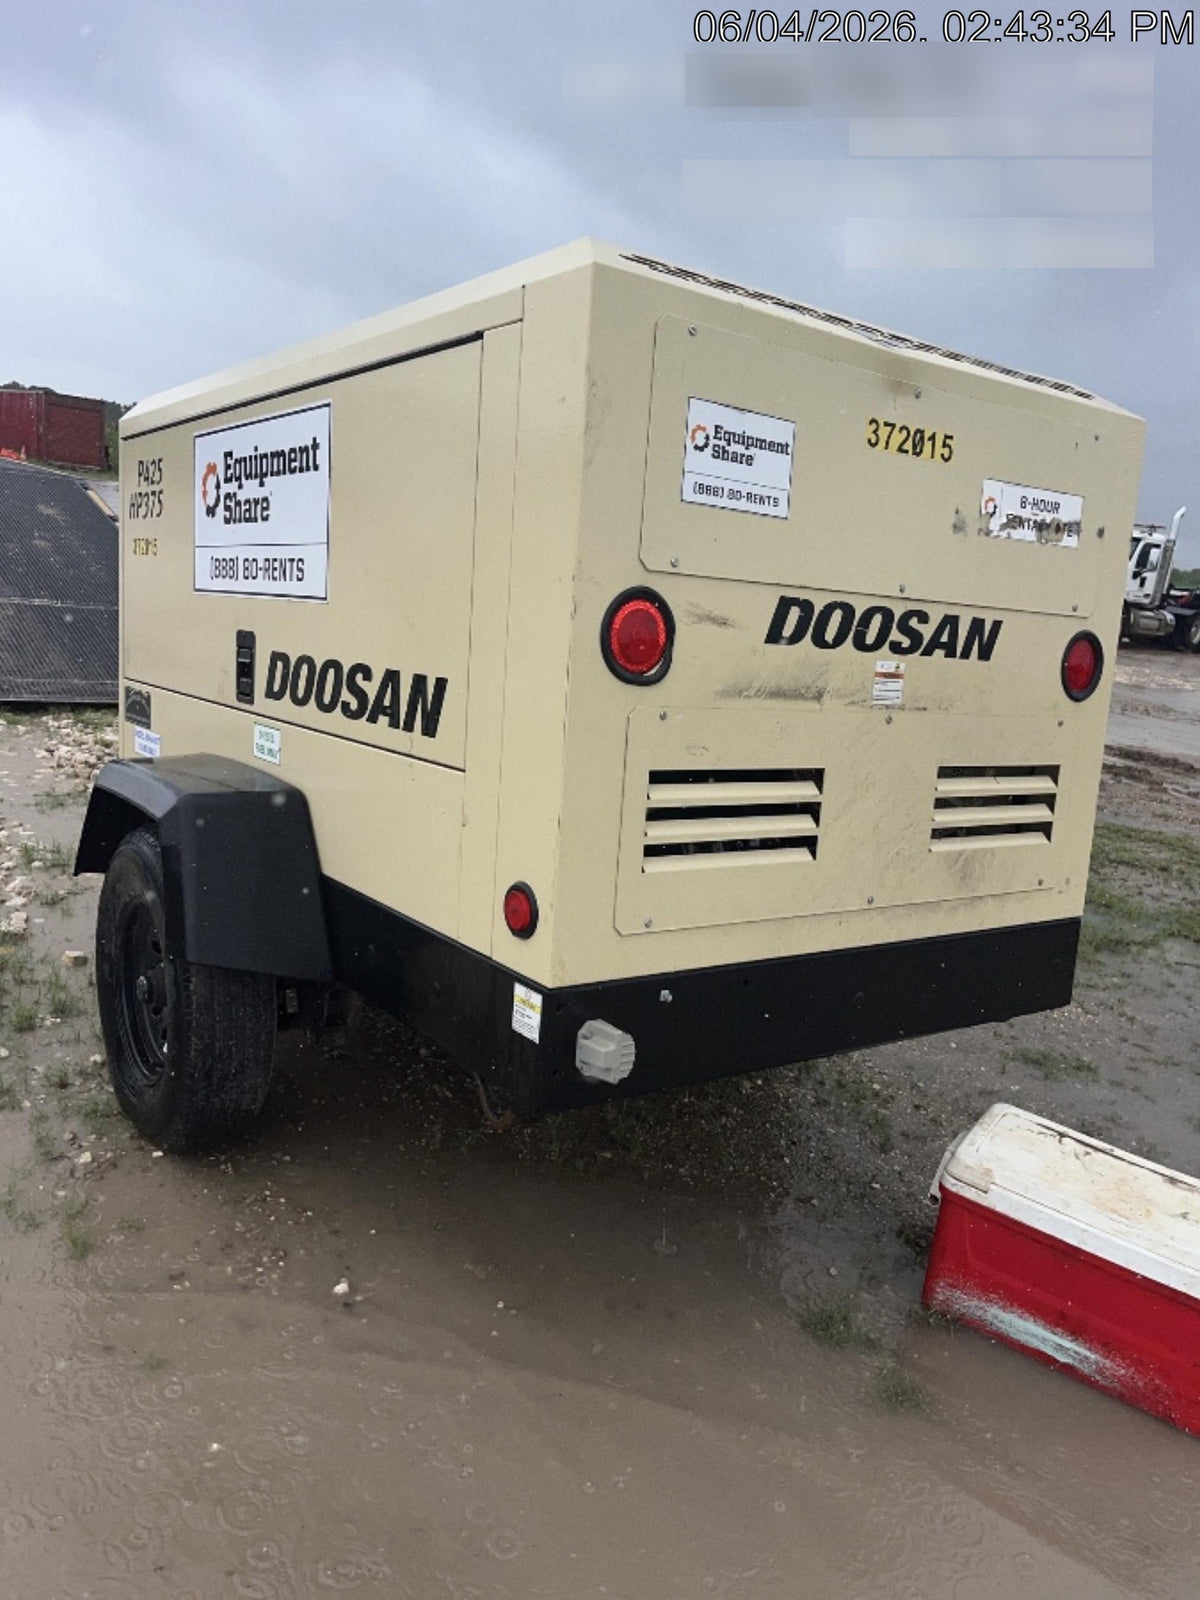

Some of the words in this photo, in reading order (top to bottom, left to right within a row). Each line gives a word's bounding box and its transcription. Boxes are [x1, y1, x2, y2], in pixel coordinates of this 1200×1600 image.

[711, 443, 755, 467] Share
[712, 424, 790, 456] Equipment
[866, 417, 954, 462] 372015
[137, 458, 163, 488] P425
[223, 436, 320, 490] Equipment
[223, 491, 271, 525] Share
[210, 556, 239, 582] (888)
[243, 557, 305, 582] 80-RENTS
[764, 594, 1003, 662] DOOSAN
[264, 650, 449, 738] DOOSAN
